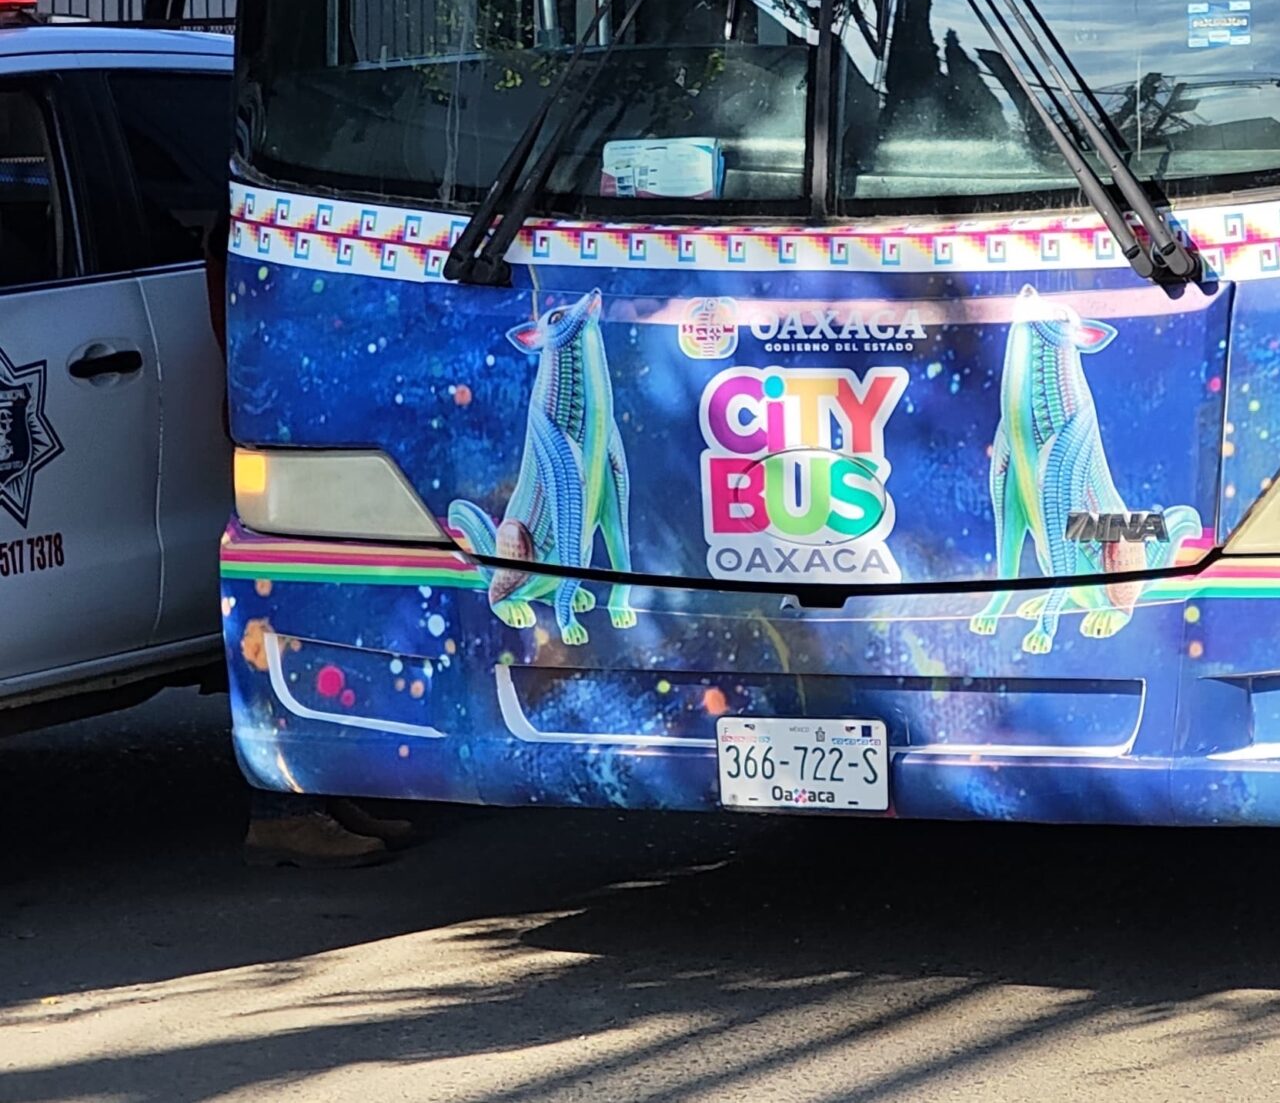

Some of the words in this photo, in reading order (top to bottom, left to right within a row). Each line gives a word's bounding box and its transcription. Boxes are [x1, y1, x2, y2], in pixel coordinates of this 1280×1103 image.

[750, 308, 928, 341] OAXACA
[764, 342, 830, 353] GOBIERNO
[834, 342, 859, 353] DEL
[864, 342, 914, 353] ESTADO
[709, 456, 885, 537] BUS
[27, 532, 65, 572] 7378
[715, 546, 890, 575] OAXACA
[725, 745, 879, 785] 366-722-S
[771, 785, 836, 804] Oaxaca
